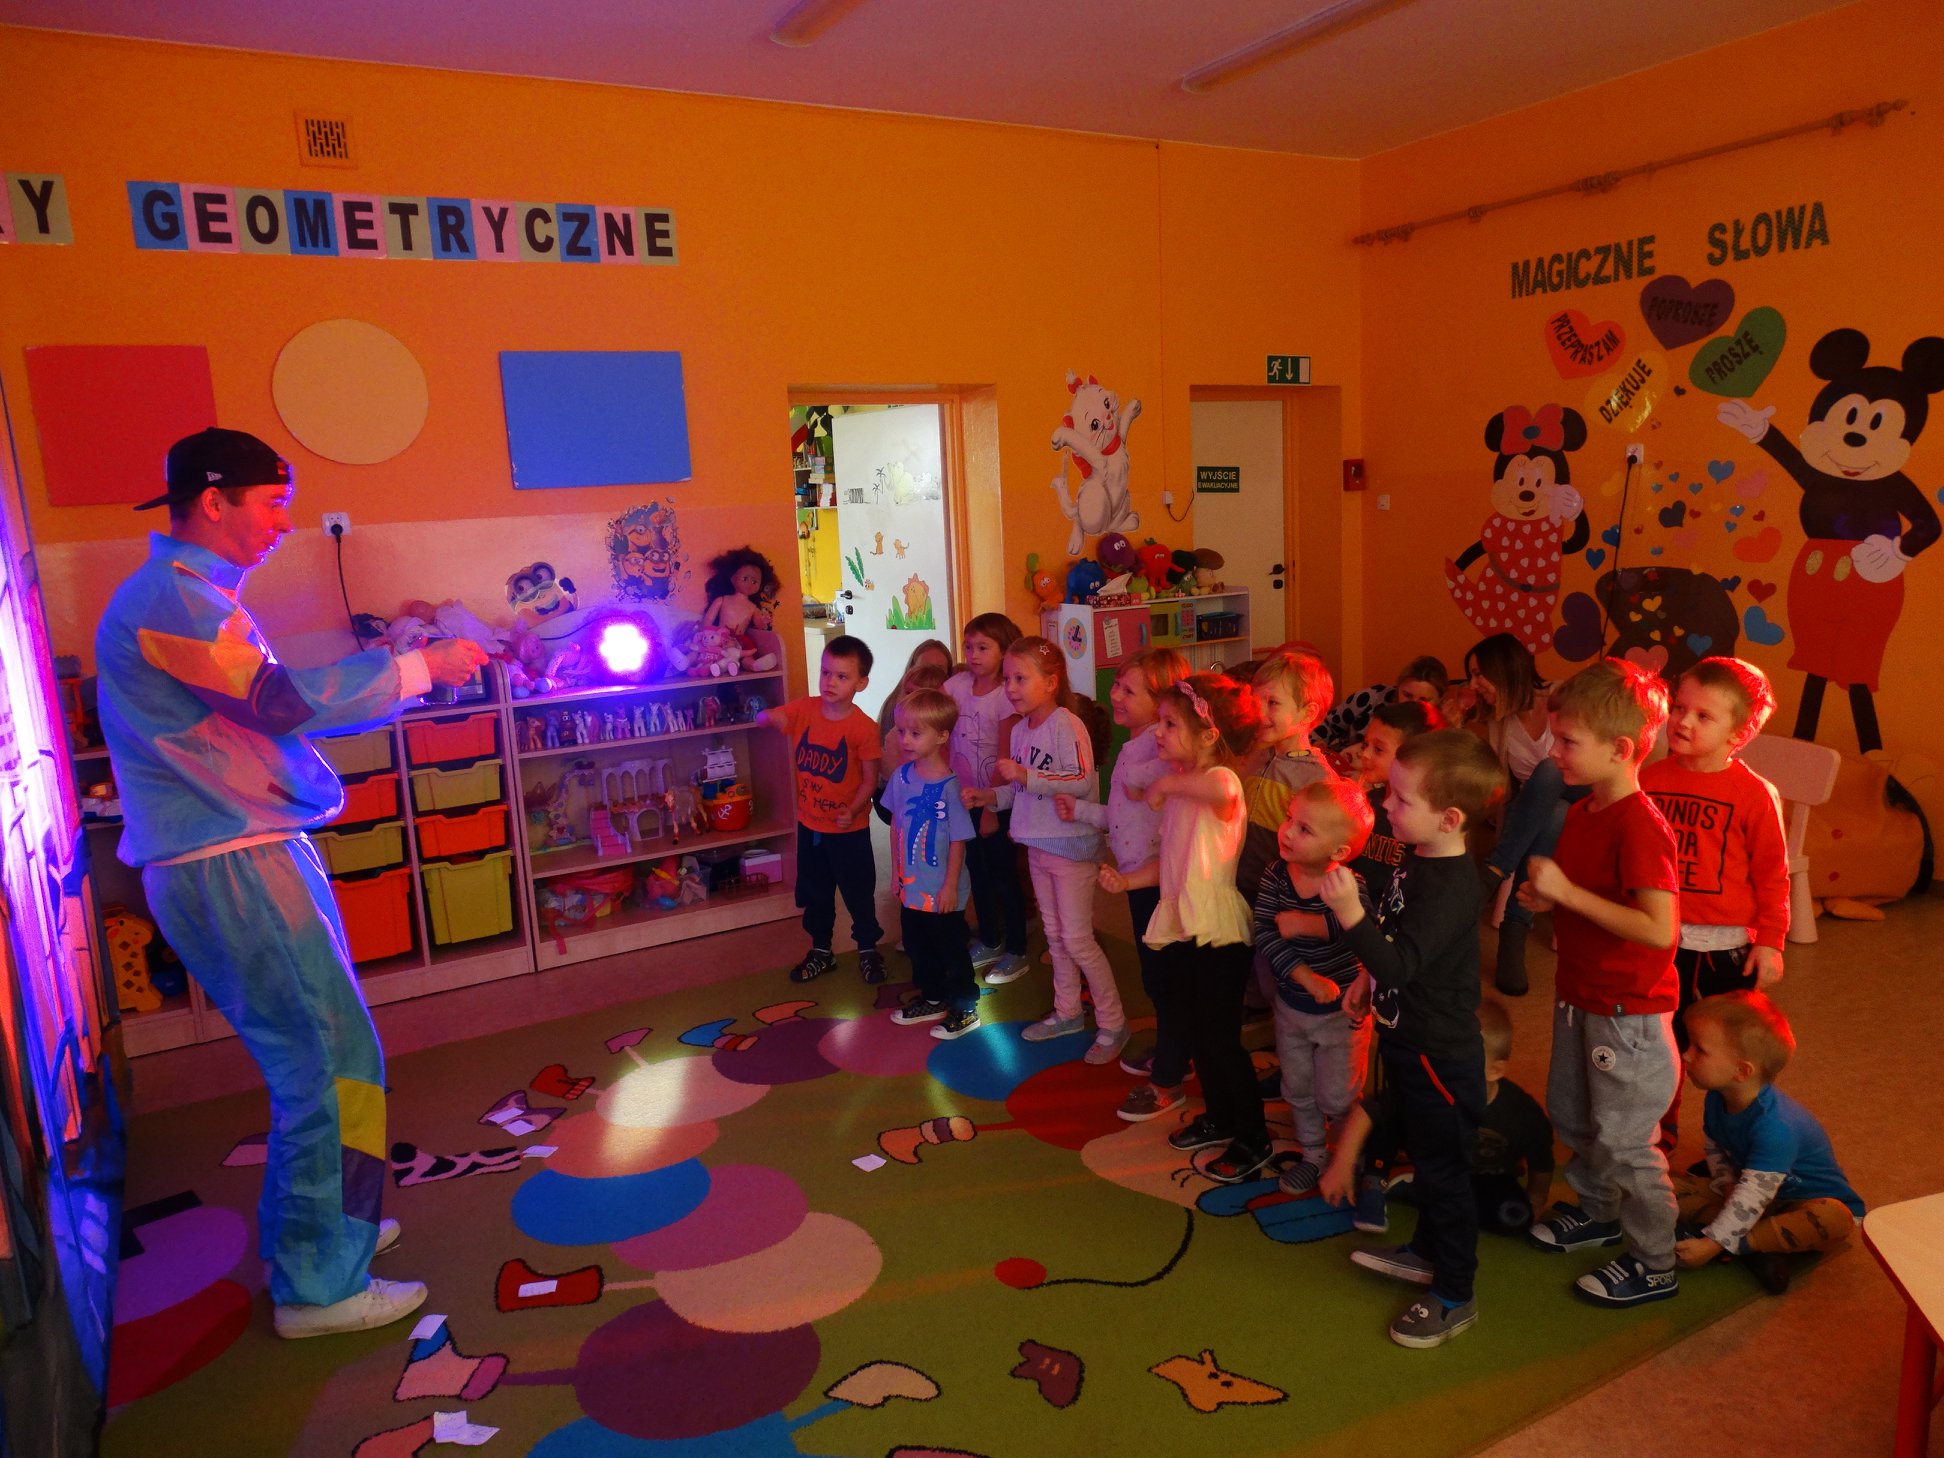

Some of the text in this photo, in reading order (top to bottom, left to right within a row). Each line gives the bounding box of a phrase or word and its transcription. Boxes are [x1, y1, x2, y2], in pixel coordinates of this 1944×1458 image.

[0, 179, 673, 257] Y GEOMETRYCZNE
[1511, 201, 1829, 299] MAGICZNE SŁOWA
[1551, 312, 1620, 366] PRZEPRASZAM
[1705, 330, 1763, 385] PROSZĘ
[1197, 481, 1239, 489] EWAKUACYJNE
[1200, 469, 1237, 480] WYJŚCIE
[797, 746, 843, 775] DADDY
